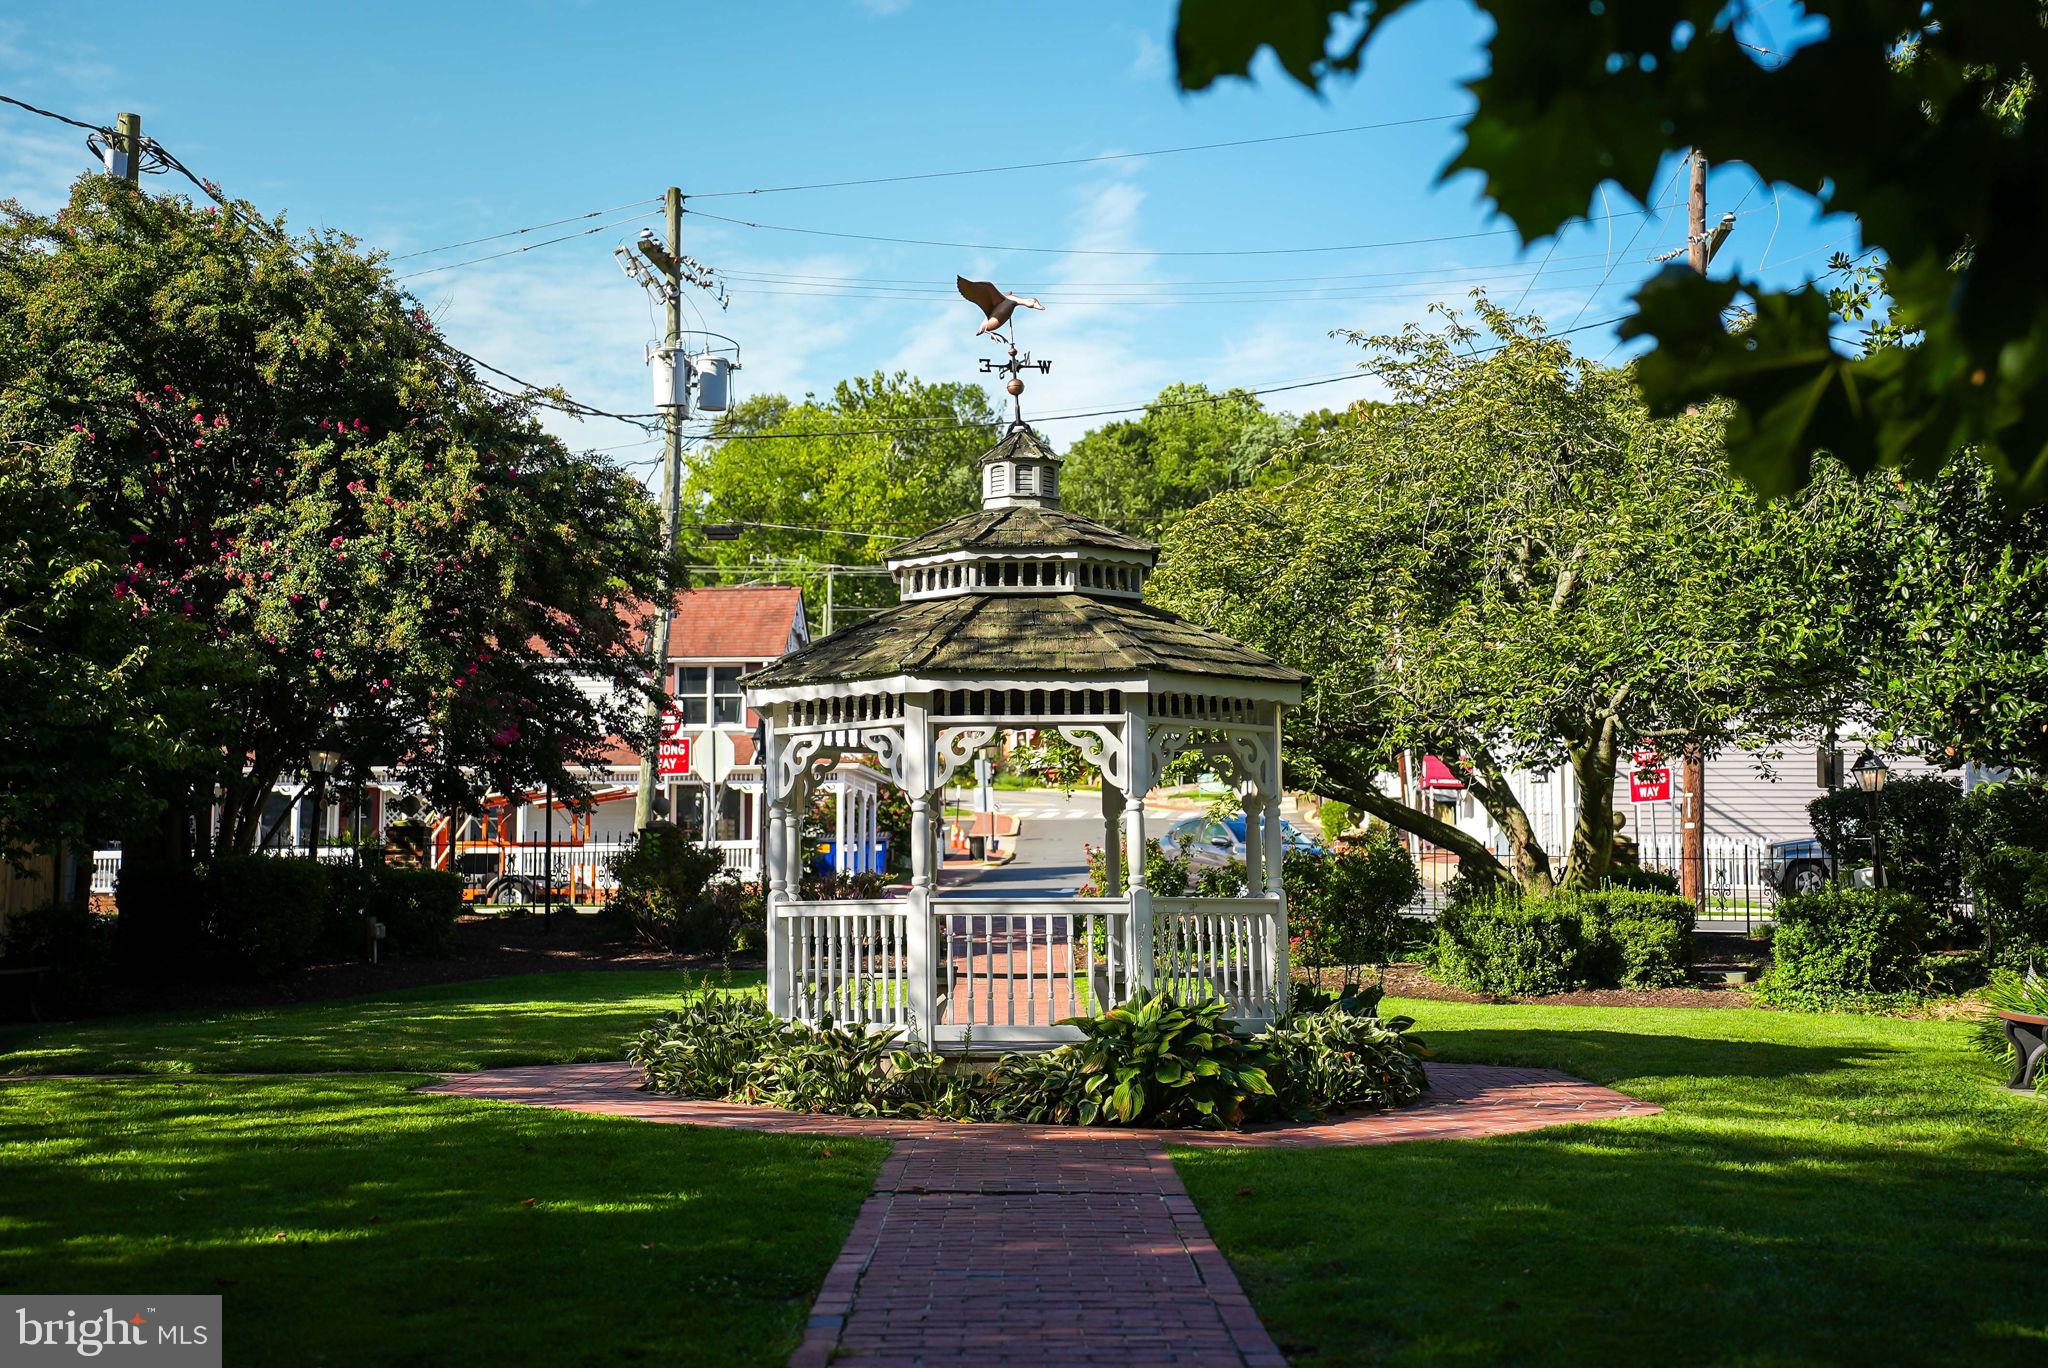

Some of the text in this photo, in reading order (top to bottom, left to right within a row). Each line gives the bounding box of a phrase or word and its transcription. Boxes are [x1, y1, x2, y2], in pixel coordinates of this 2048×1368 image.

[1037, 360, 1052, 374] W
[659, 743, 685, 755] RONG
[1639, 786, 1659, 797] WAY
